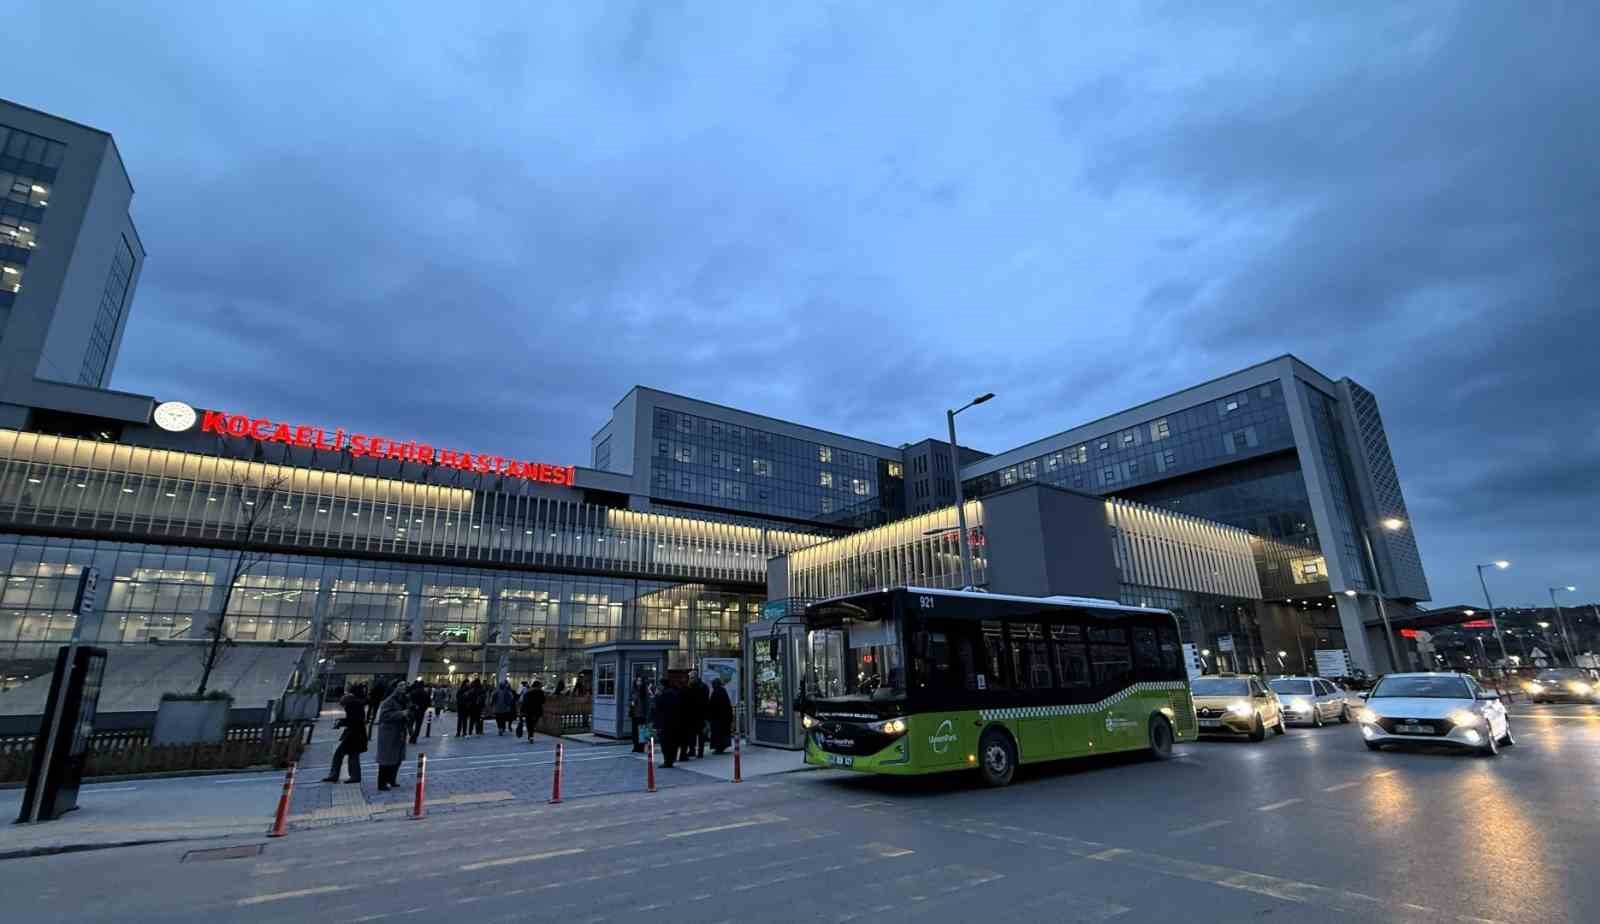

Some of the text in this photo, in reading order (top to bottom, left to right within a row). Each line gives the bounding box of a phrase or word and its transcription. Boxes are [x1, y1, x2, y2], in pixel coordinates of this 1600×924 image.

[201, 410, 576, 487] KOCAELİ ŞEHİR HASTANESİ
[919, 595, 935, 609] 921
